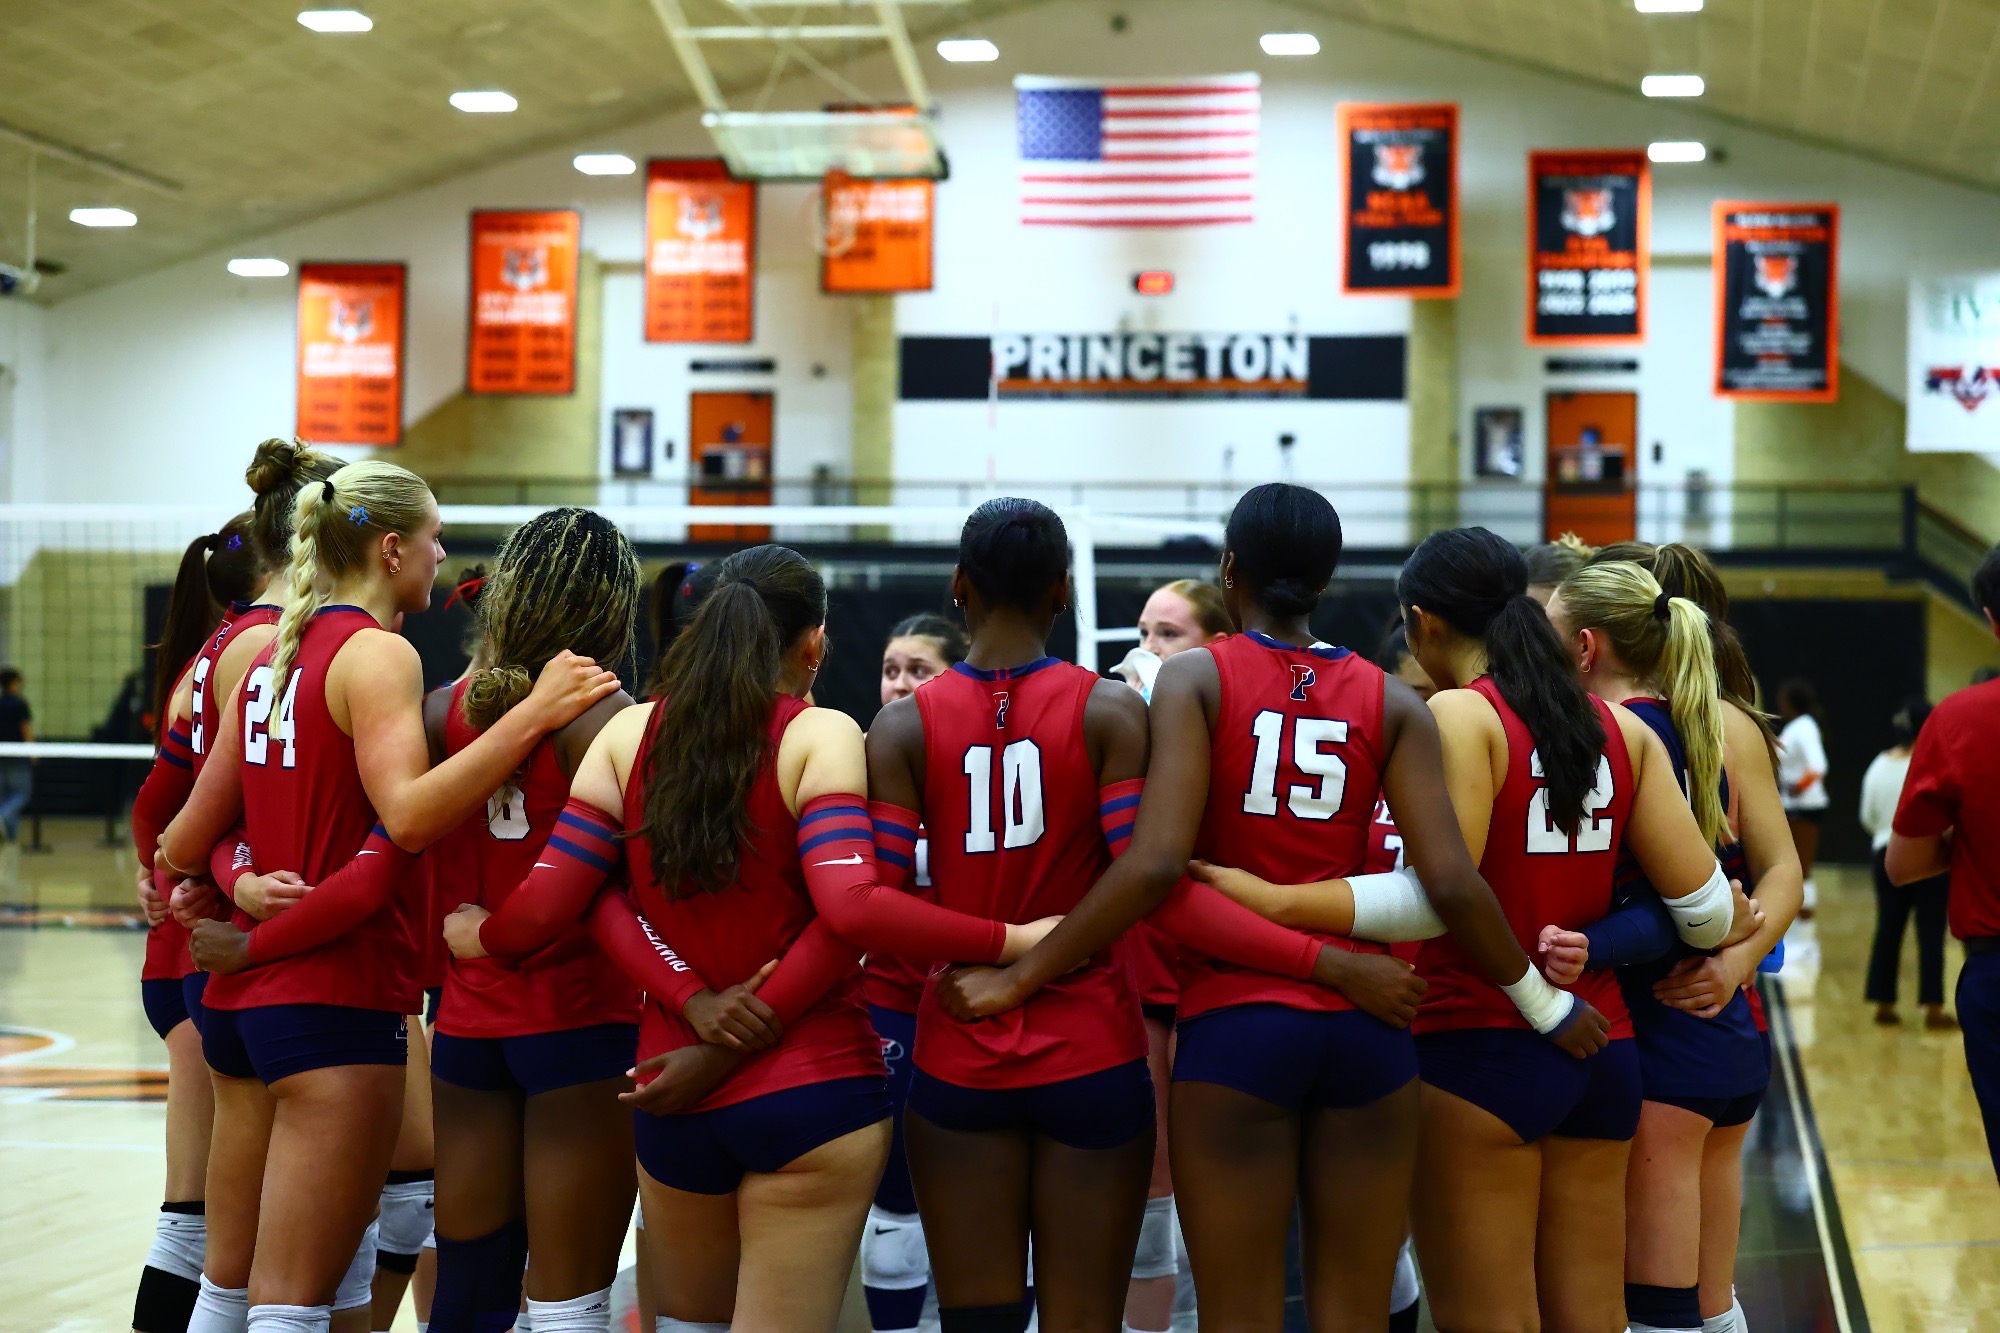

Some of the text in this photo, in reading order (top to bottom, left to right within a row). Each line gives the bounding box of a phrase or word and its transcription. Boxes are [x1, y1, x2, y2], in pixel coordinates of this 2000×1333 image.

[994, 336, 1309, 382] PRINCETON
[245, 666, 303, 767] 24
[1290, 664, 1316, 701] P
[964, 738, 1045, 853] 10
[1243, 709, 1349, 821] 15
[1526, 748, 1615, 854] 22
